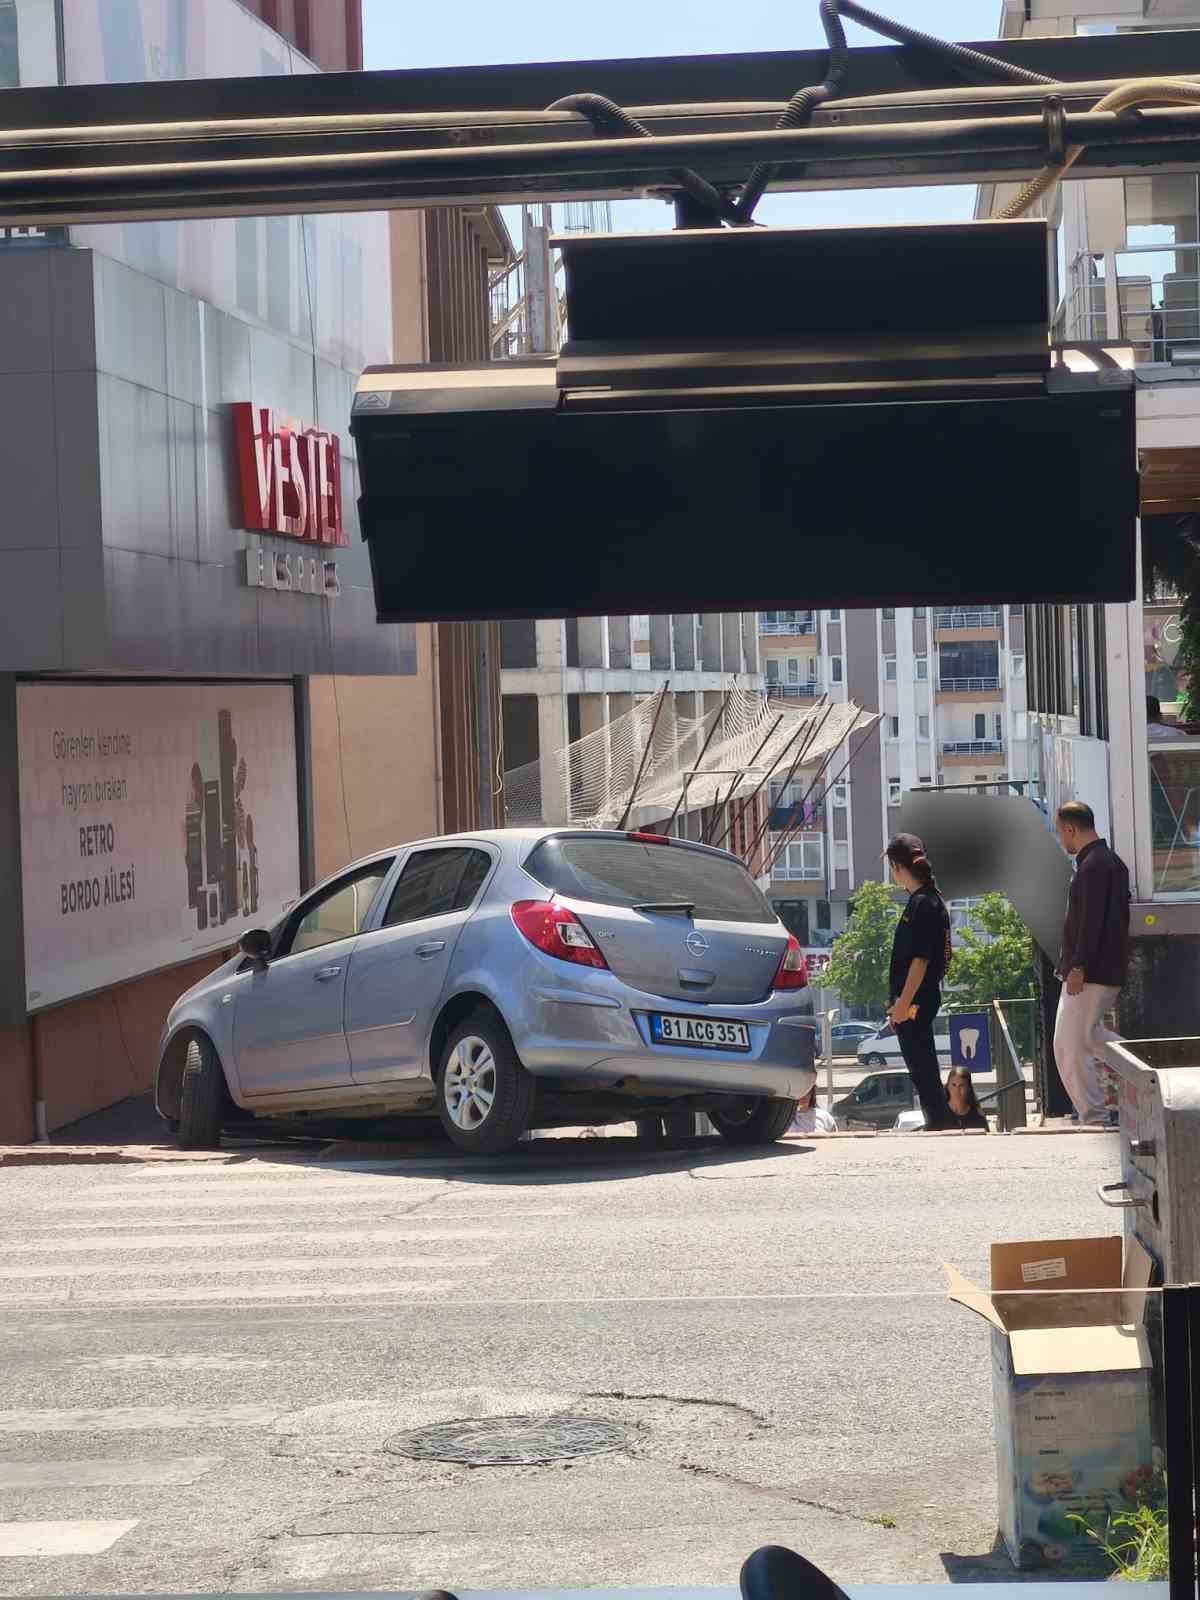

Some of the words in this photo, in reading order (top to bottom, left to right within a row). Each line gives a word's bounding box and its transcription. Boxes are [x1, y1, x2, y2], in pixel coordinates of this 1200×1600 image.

[62, 776, 93, 810] hayran
[80, 823, 114, 856] RETRO
[61, 877, 100, 915] BORDO
[104, 862, 136, 905] AİLESİ
[663, 1018, 681, 1038] 81
[686, 1021, 715, 1041] ACG
[716, 1025, 746, 1044] 351
